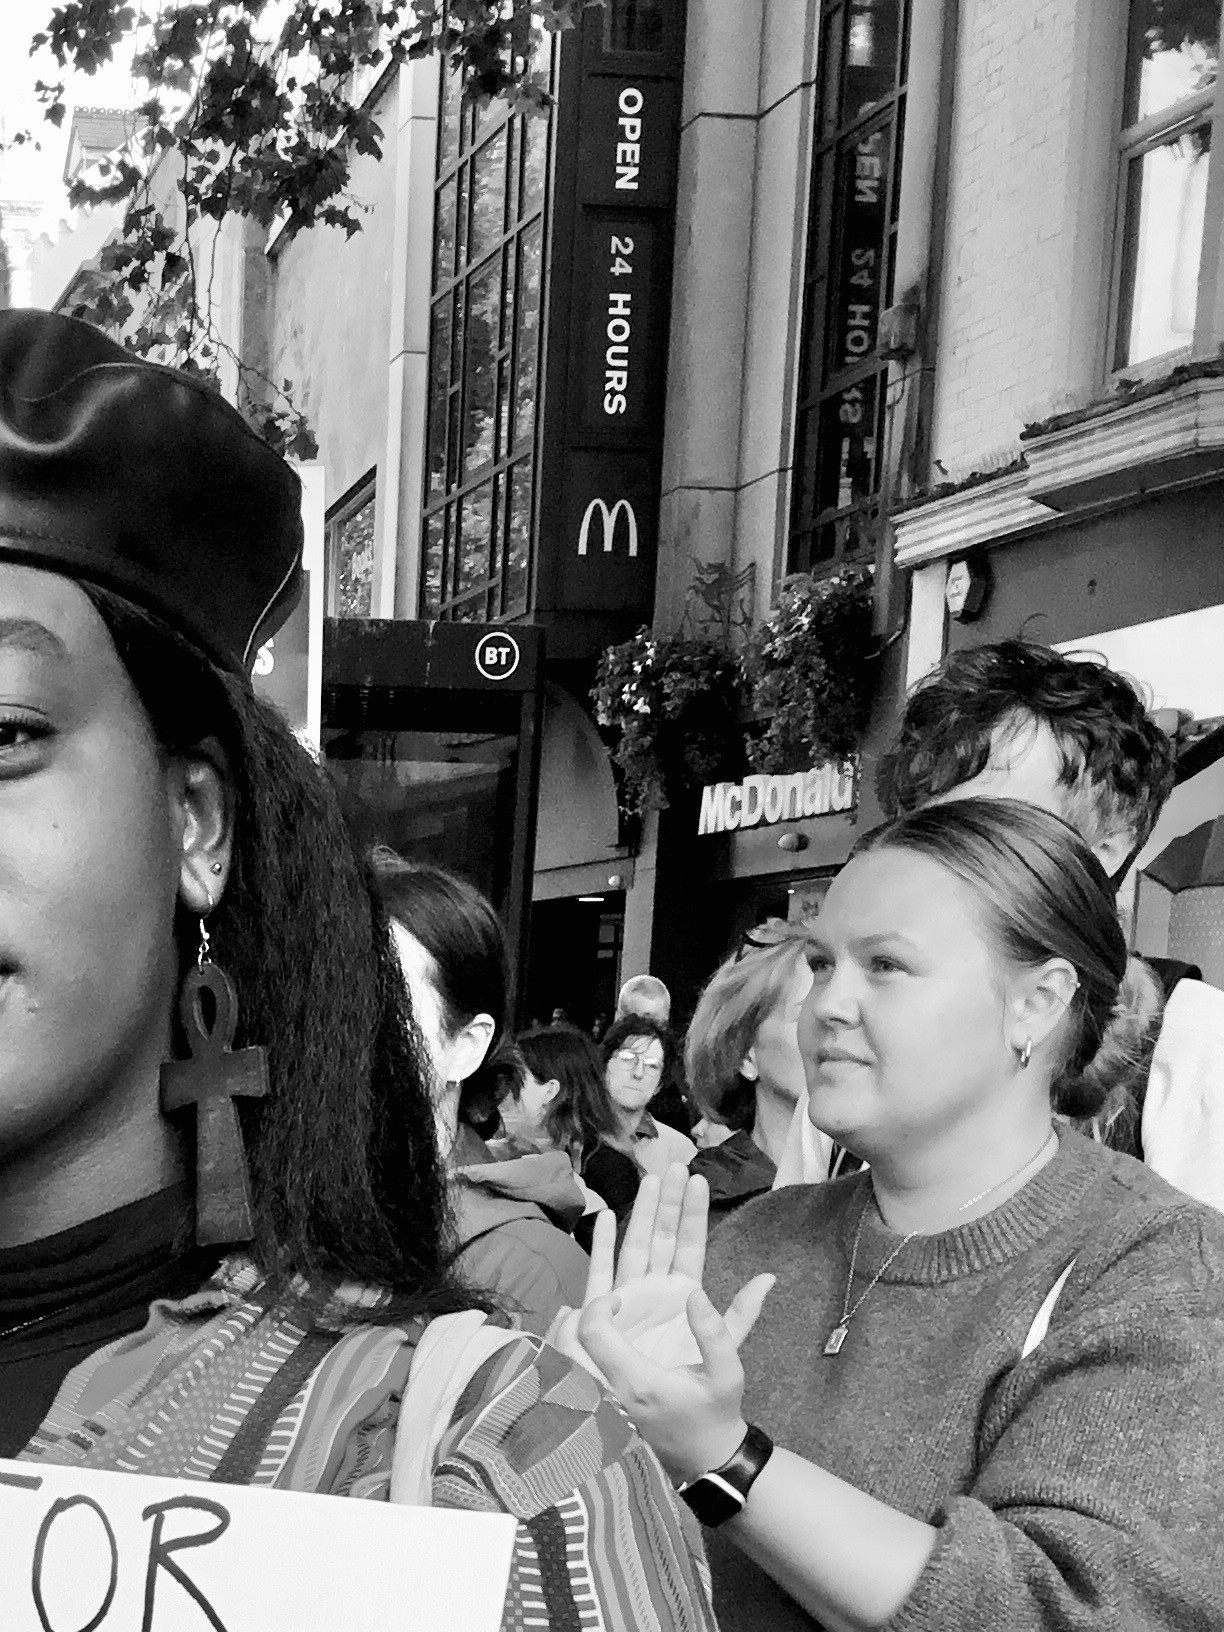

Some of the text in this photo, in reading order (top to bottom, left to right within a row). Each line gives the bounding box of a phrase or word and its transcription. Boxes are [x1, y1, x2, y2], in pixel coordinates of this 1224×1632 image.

[603, 87, 644, 415] OPEN 24 HOURS
[485, 646, 511, 665] BT
